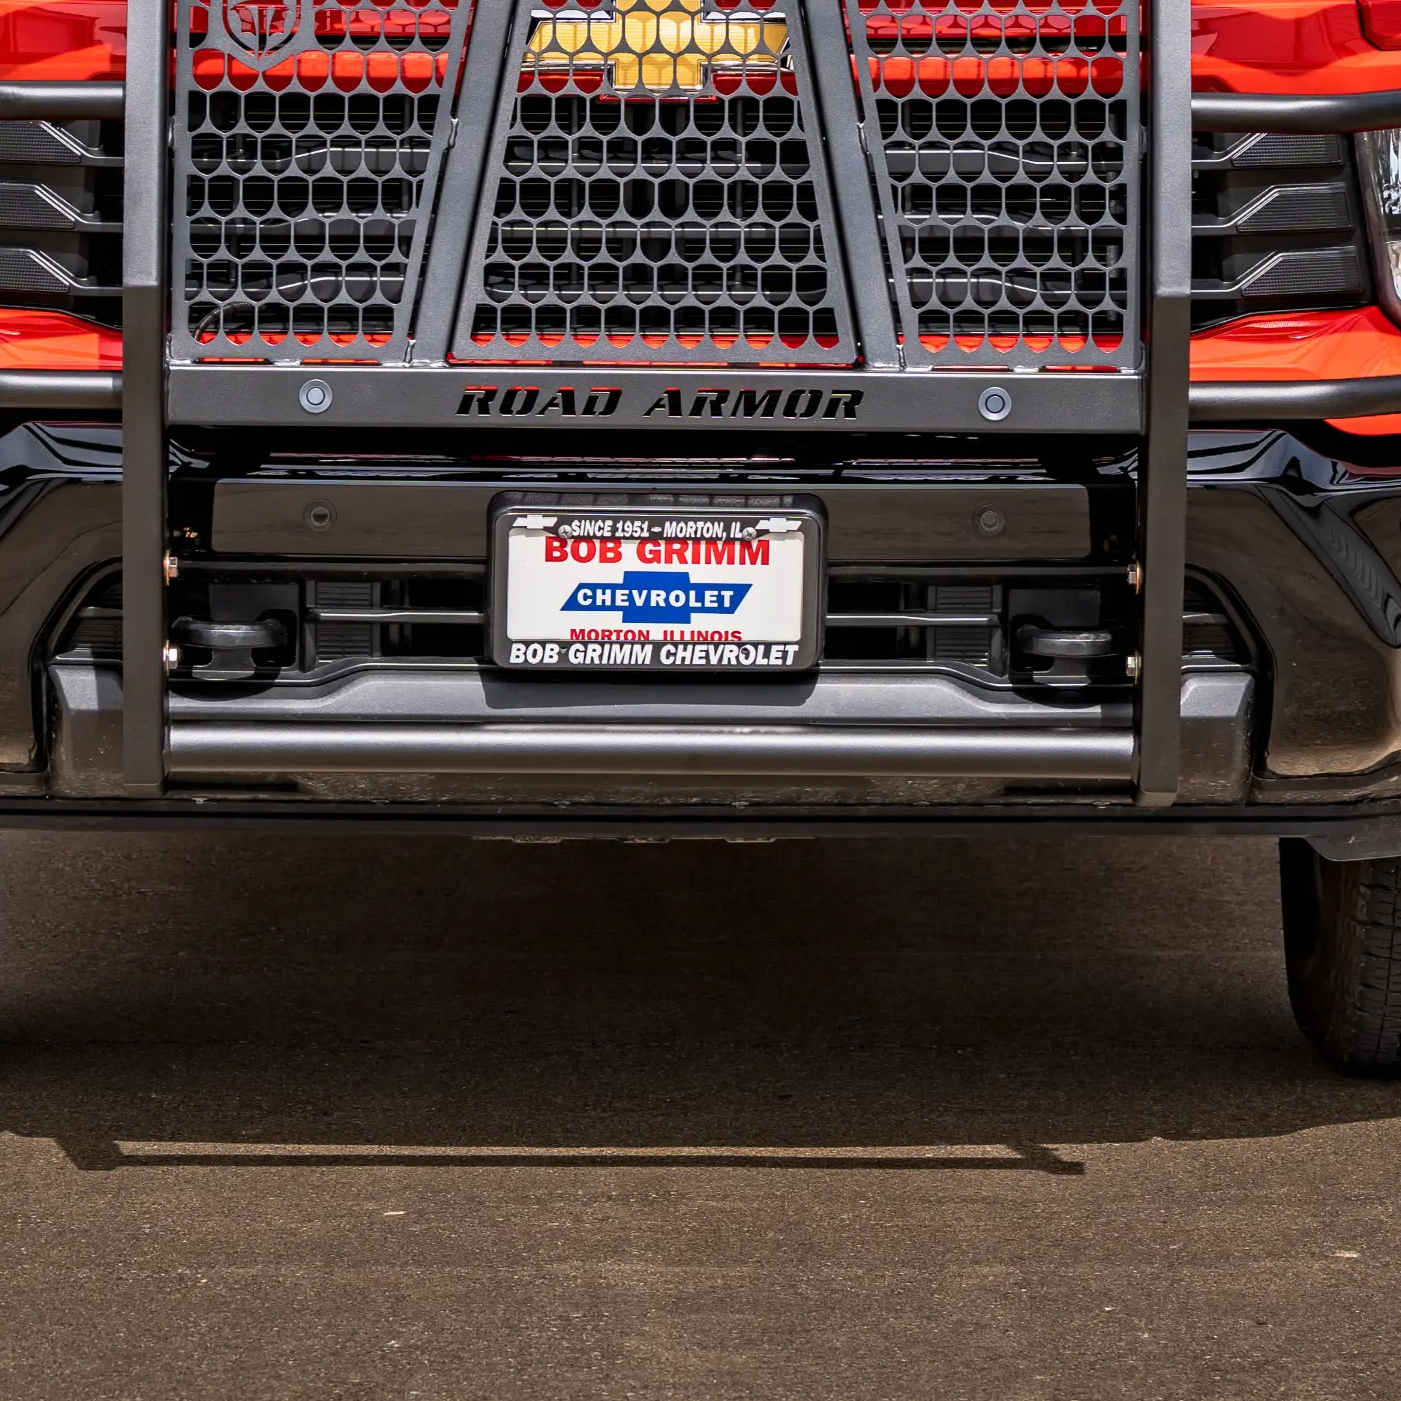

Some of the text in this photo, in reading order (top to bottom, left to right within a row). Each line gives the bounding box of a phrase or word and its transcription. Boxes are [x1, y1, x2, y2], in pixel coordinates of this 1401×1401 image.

[455, 386, 864, 420] ROAD ARMOR
[571, 519, 743, 541] SINCE 1951 MORTON, IL
[545, 536, 770, 565] BOB GRIMM
[577, 589, 734, 608] CHEVROLET
[663, 630, 743, 642] ILLINOIS
[509, 643, 799, 666] BOB GRIMM CHEVROLET
